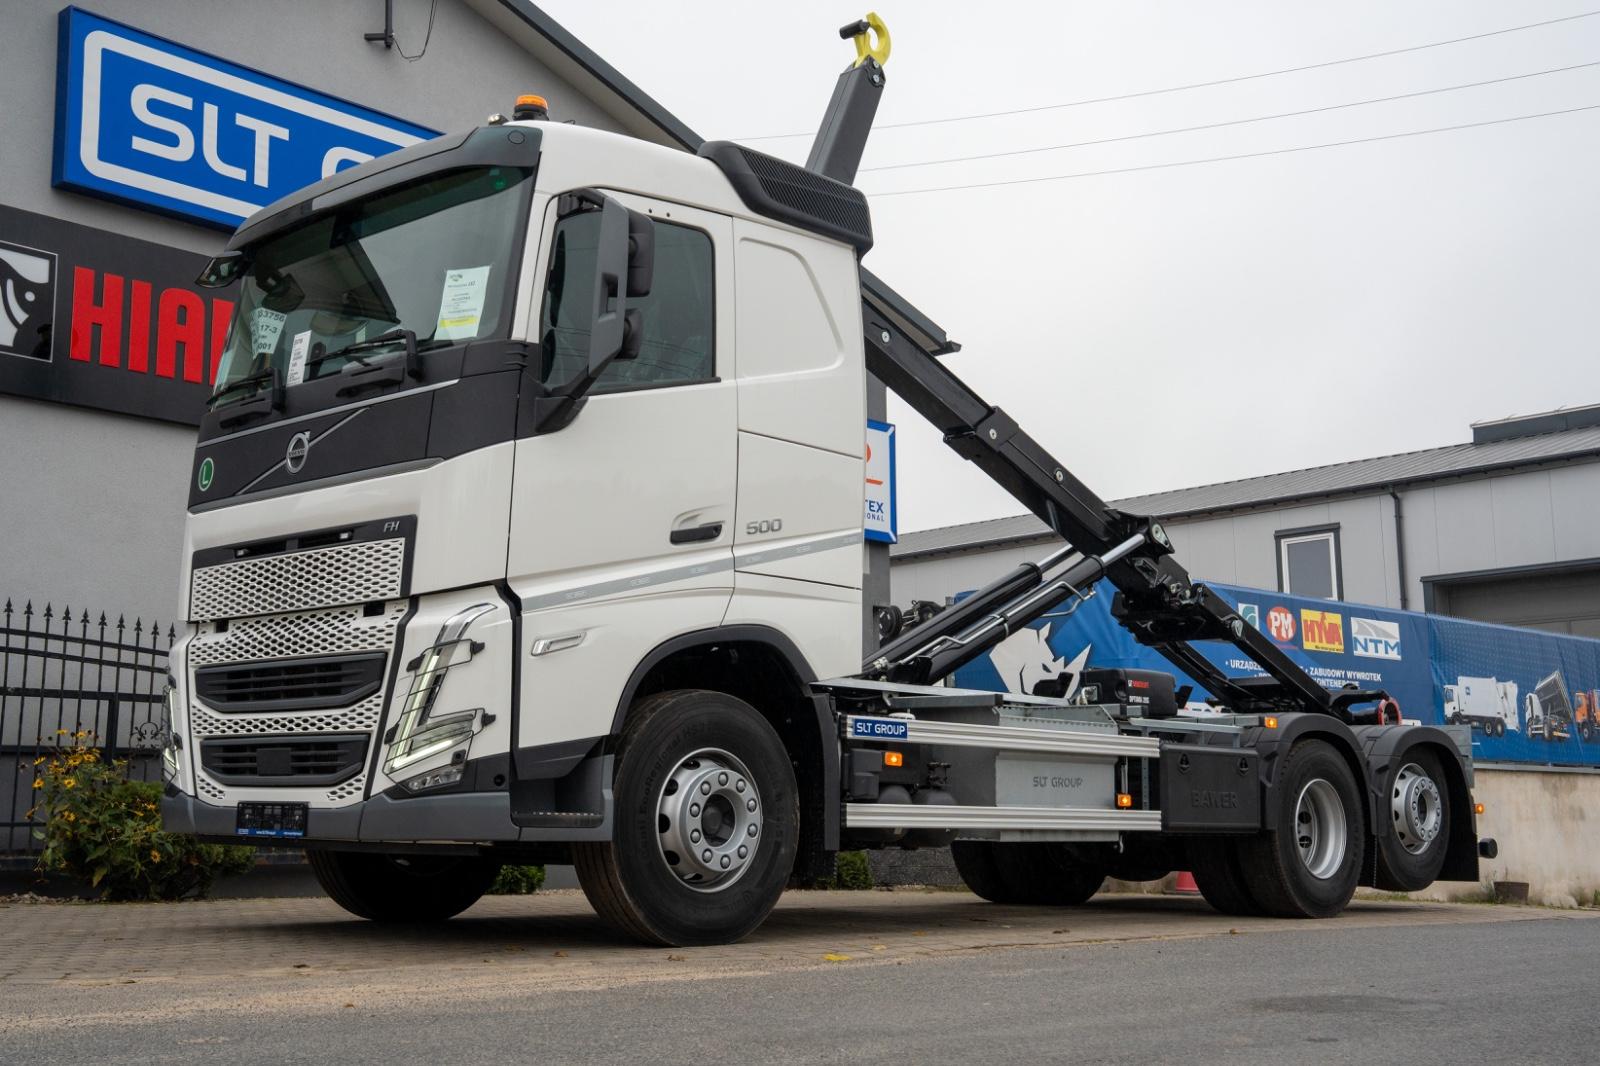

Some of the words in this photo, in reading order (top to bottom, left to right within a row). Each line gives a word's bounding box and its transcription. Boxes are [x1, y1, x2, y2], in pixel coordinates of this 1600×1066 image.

[131, 83, 289, 189] SLT
[202, 465, 209, 485] L
[864, 512, 884, 522] ONAL
[383, 521, 400, 533] FH
[746, 518, 782, 535] 500
[1269, 610, 1295, 639] PM
[1302, 613, 1343, 646] HYVA
[1353, 636, 1400, 656] NTM
[1230, 660, 1264, 672] URZĄDZE
[1310, 666, 1345, 678] ZABUDOWY
[856, 722, 872, 733] SLT
[874, 723, 905, 735] GROUP
[1033, 776, 1048, 787] SLT
[1051, 776, 1083, 788] GROUP
